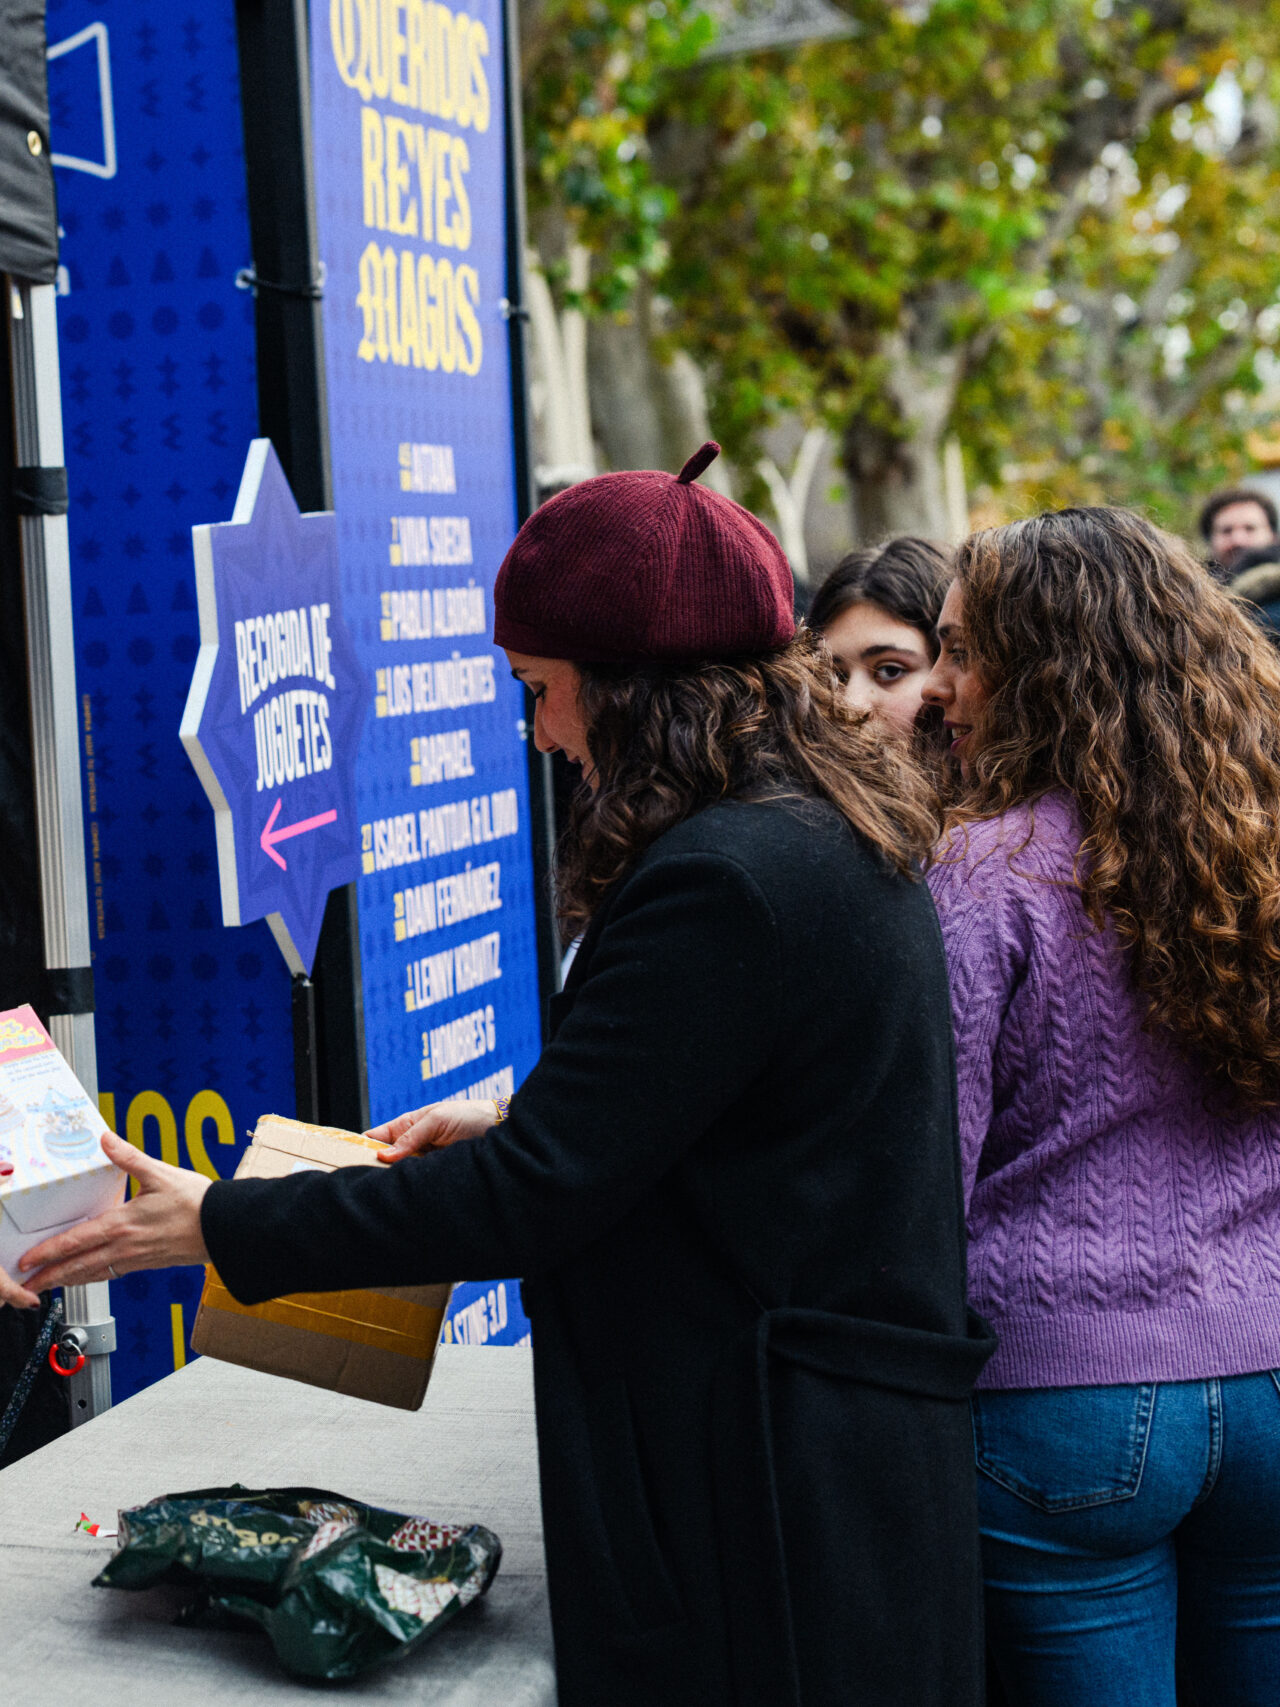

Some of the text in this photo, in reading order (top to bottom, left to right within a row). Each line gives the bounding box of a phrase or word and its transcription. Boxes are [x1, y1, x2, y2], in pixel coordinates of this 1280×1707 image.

[329, 0, 492, 133] QUERIDOS
[360, 106, 472, 252] REYES
[356, 241, 483, 377] MAGOS
[234, 607, 314, 715] RECOGIDA
[309, 602, 336, 691] DE
[253, 689, 333, 793] JUGUETES
[373, 812, 421, 872] ISABEL
[404, 880, 437, 938] DANI
[413, 948, 454, 1010] LENNY
[429, 1008, 487, 1078] HOMBRES
